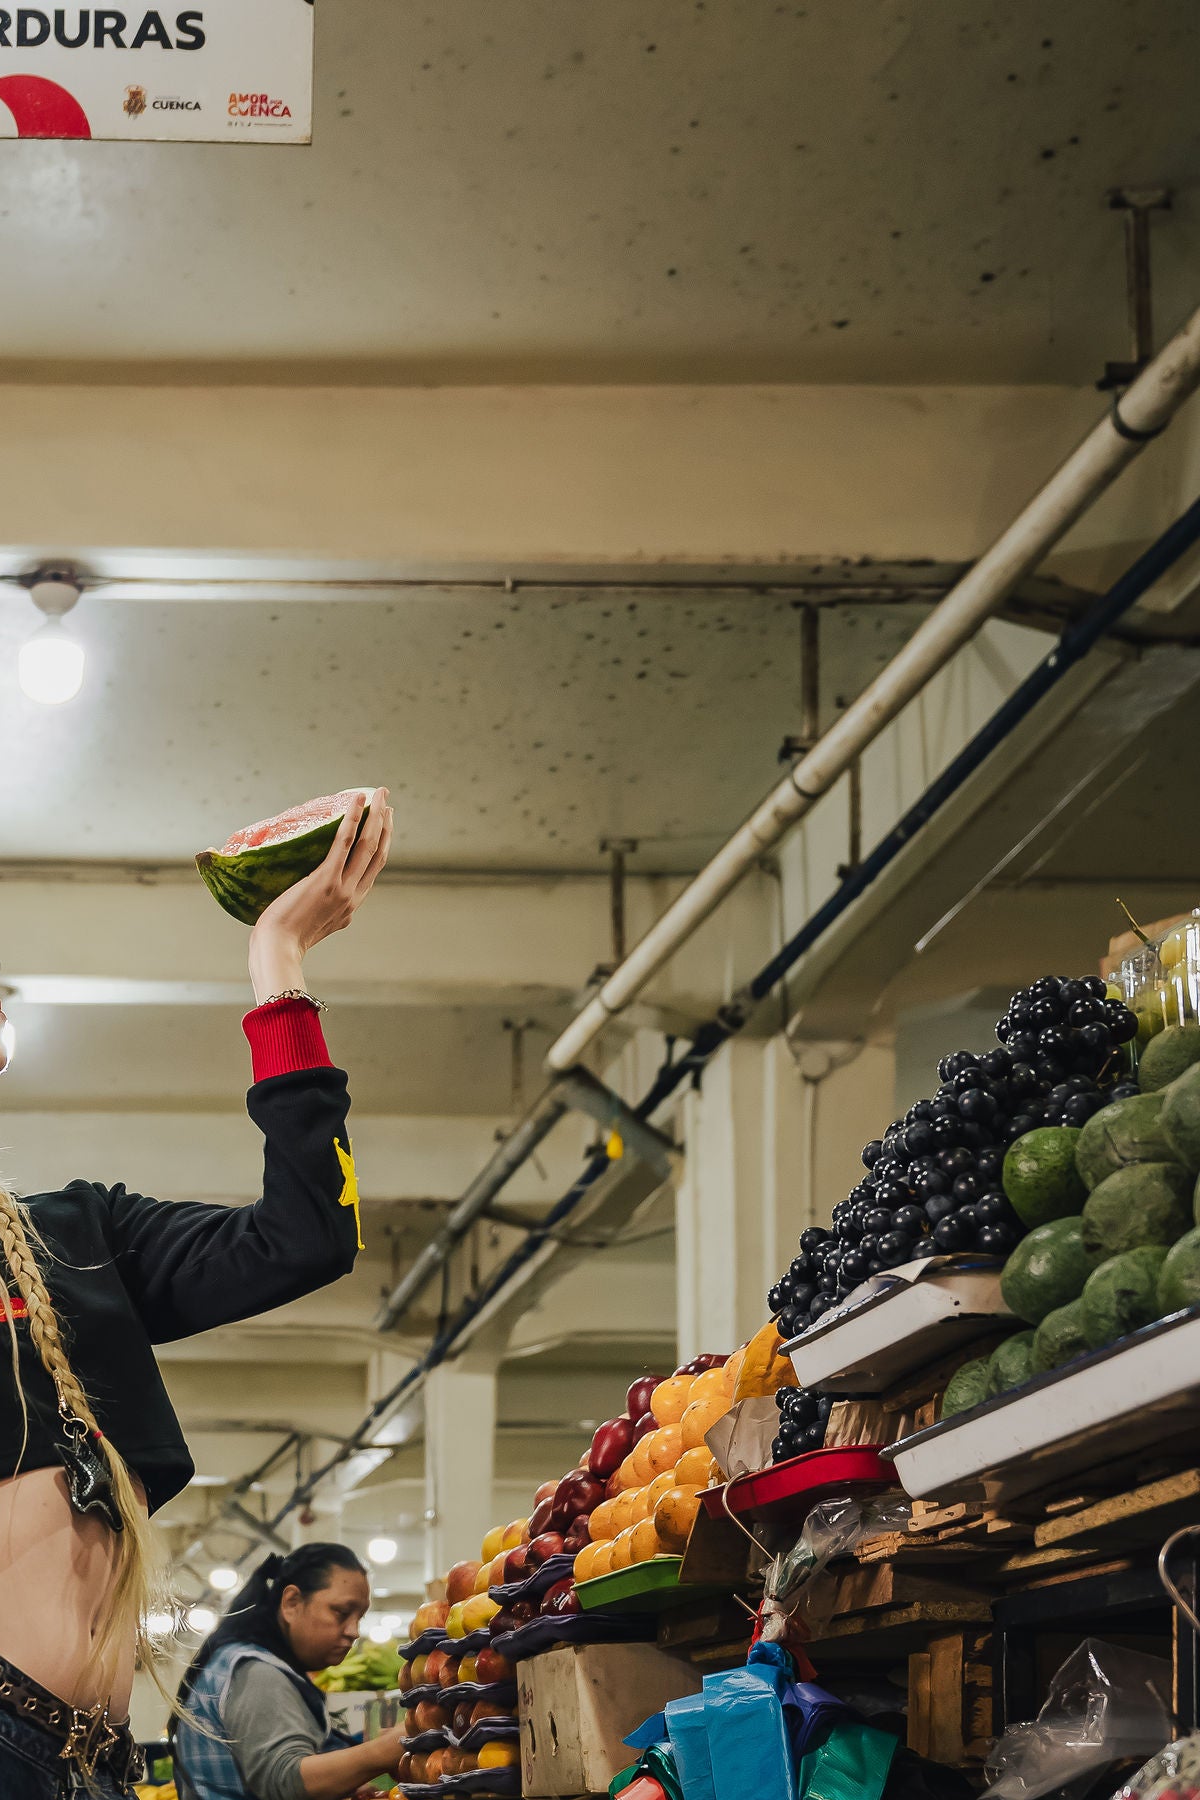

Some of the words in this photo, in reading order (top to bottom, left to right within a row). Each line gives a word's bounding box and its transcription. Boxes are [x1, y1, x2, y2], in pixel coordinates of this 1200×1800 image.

[229, 93, 268, 104] AMOR
[152, 100, 202, 111] CUENCA
[228, 104, 292, 118] CUENCA
